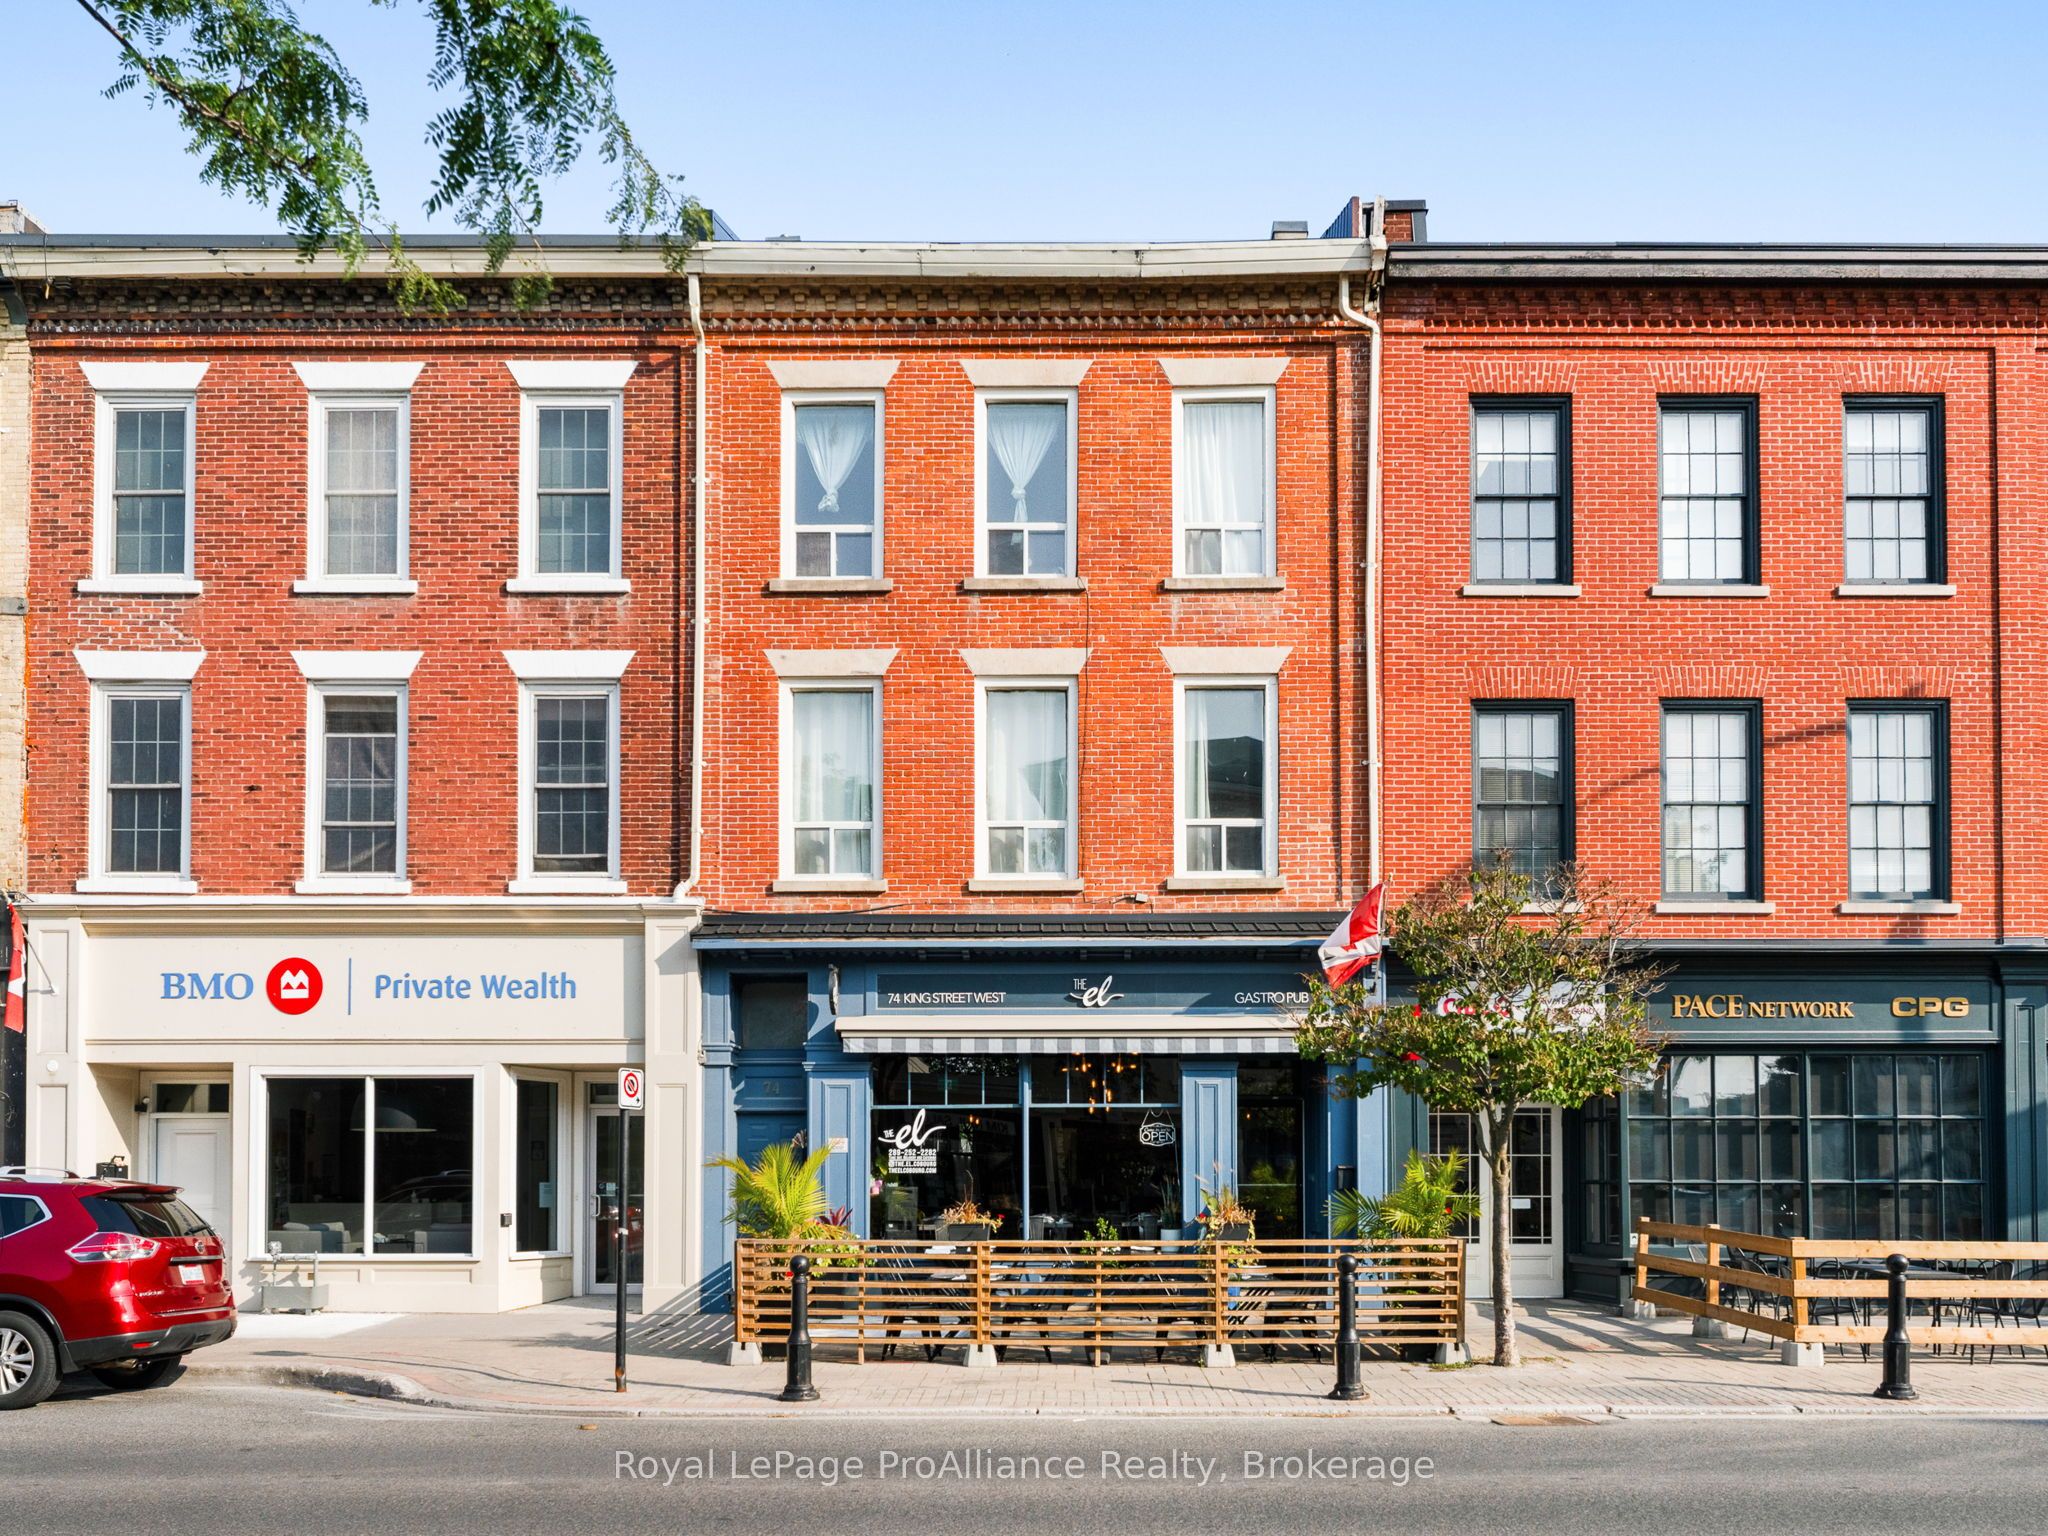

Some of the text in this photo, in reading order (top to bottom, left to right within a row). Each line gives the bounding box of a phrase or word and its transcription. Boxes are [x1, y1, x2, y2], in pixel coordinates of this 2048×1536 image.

[160, 971, 577, 1000] BMO Private Wealth
[1073, 978, 1087, 990] THE
[1070, 975, 1124, 1007] el
[1235, 991, 1310, 1004] GASTRO PUB
[887, 992, 1006, 1004] 74 KING STREET WEST
[1671, 994, 1855, 1019] PACE NETWORK
[1891, 996, 1970, 1018] CPG
[878, 1108, 947, 1150] el
[883, 1128, 895, 1139] THE
[1141, 1131, 1174, 1141] OPEN
[888, 1148, 937, 1156] 289-252-2282
